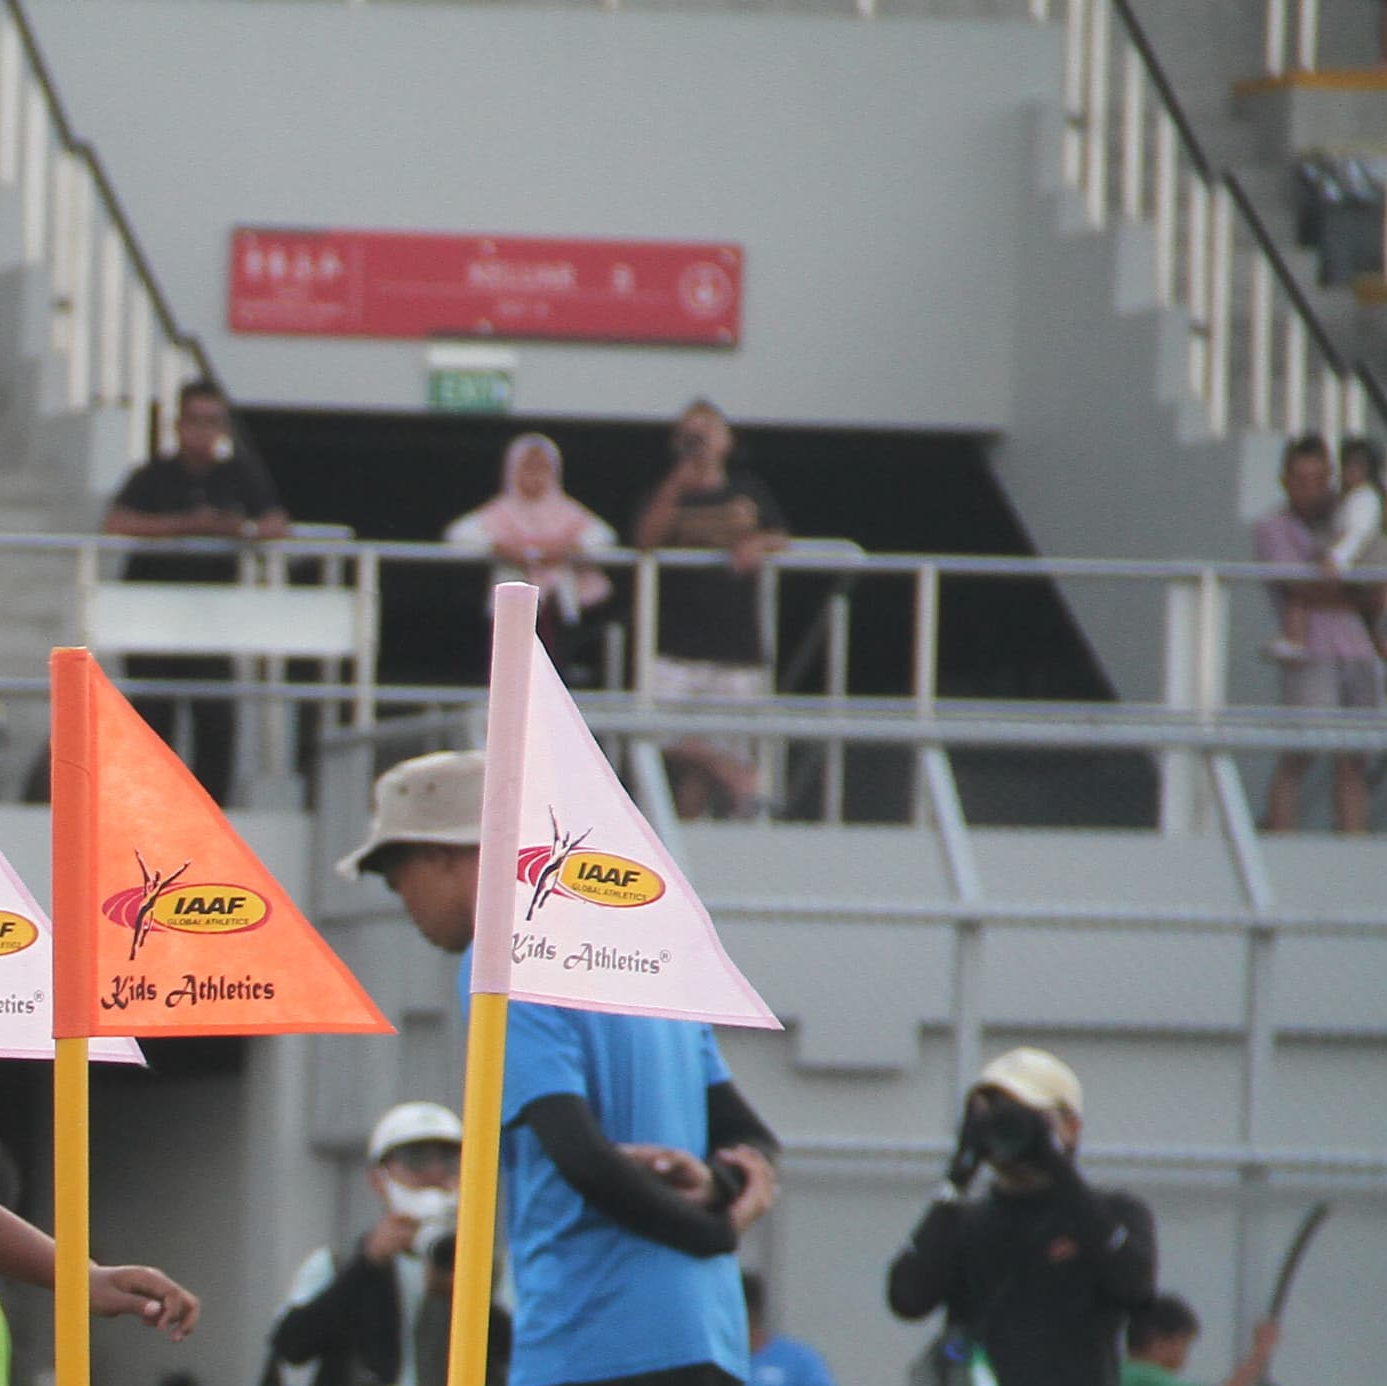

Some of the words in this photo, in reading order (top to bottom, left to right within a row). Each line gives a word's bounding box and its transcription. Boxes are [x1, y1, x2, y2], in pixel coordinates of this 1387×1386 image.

[577, 862, 642, 887] IAAF
[571, 882, 603, 895] GLOBAL
[604, 888, 648, 902] ATHLETICS
[173, 897, 247, 915] IAAF
[166, 917, 201, 926] GLOBAL
[205, 917, 249, 926] ATHLETICS
[511, 933, 558, 964] Kids
[100, 975, 157, 1009] Kids
[165, 974, 275, 1008] Athletics
